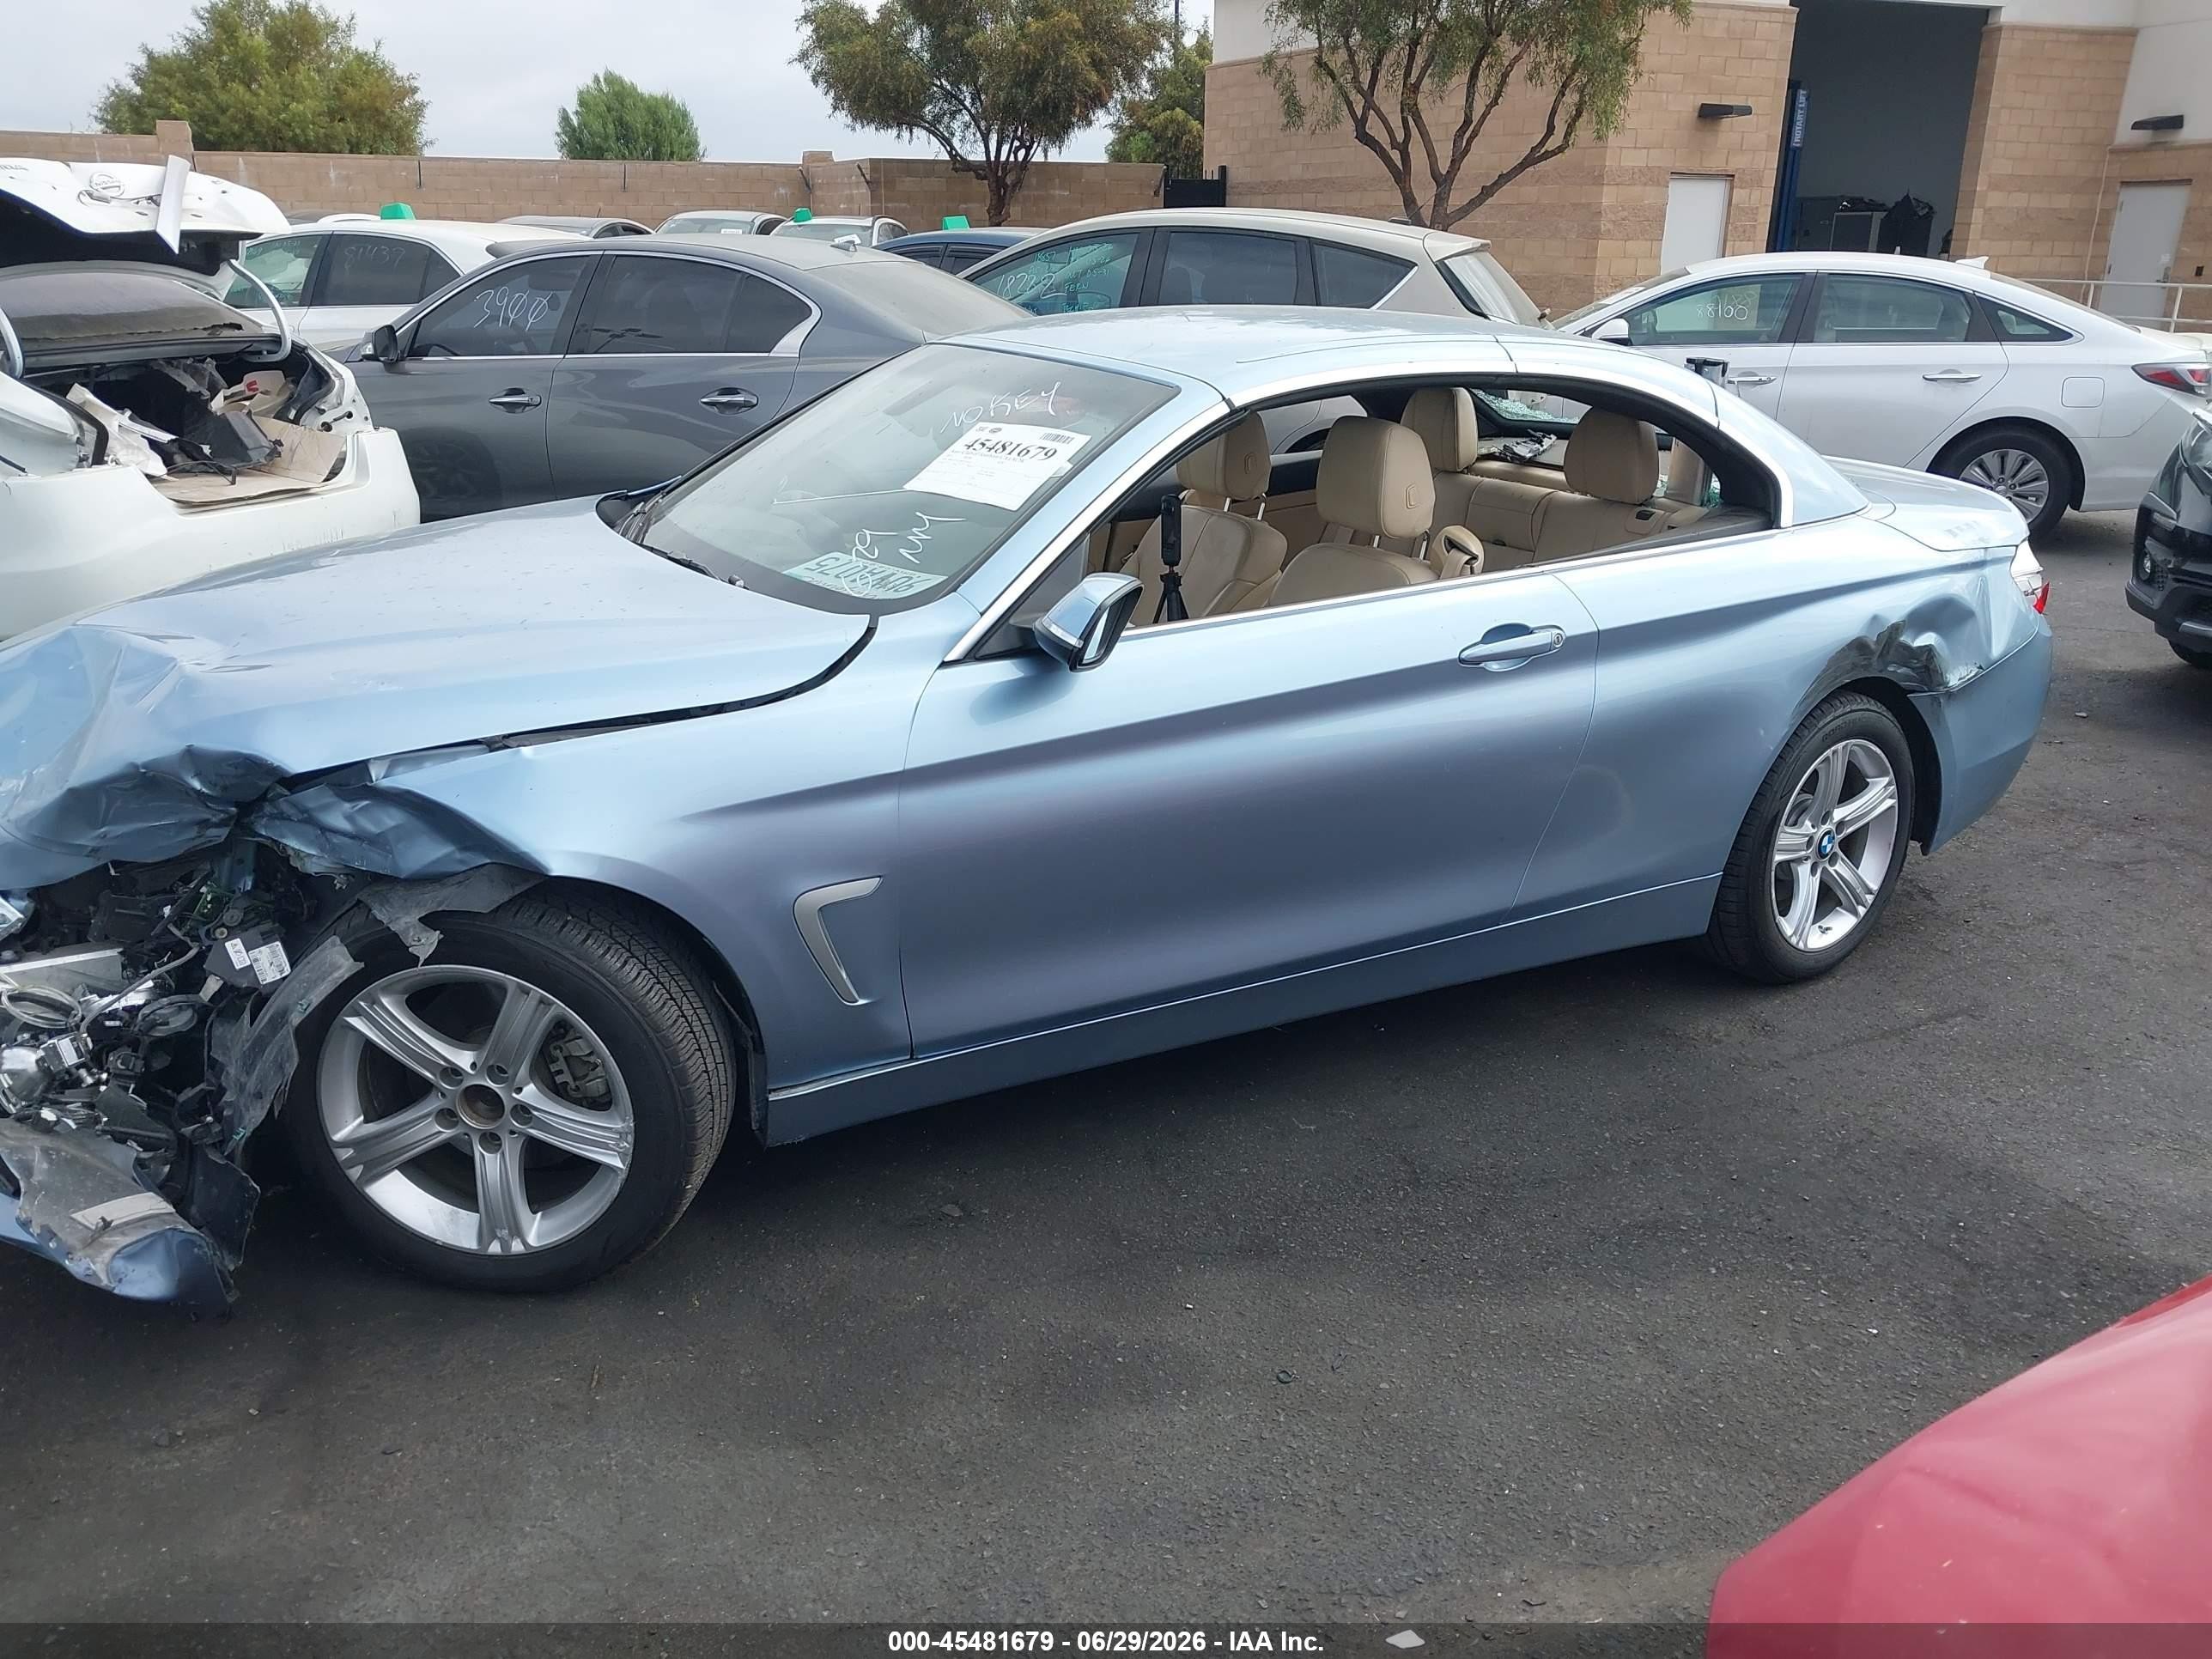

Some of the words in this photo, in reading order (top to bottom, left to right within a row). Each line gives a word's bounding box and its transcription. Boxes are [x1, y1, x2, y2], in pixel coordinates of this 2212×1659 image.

[1794, 109, 1805, 143] ROTARY
[474, 286, 553, 331] 3900
[940, 405, 983, 434] NO
[989, 381, 1061, 417] KEY
[964, 437, 1057, 461] 45481679
